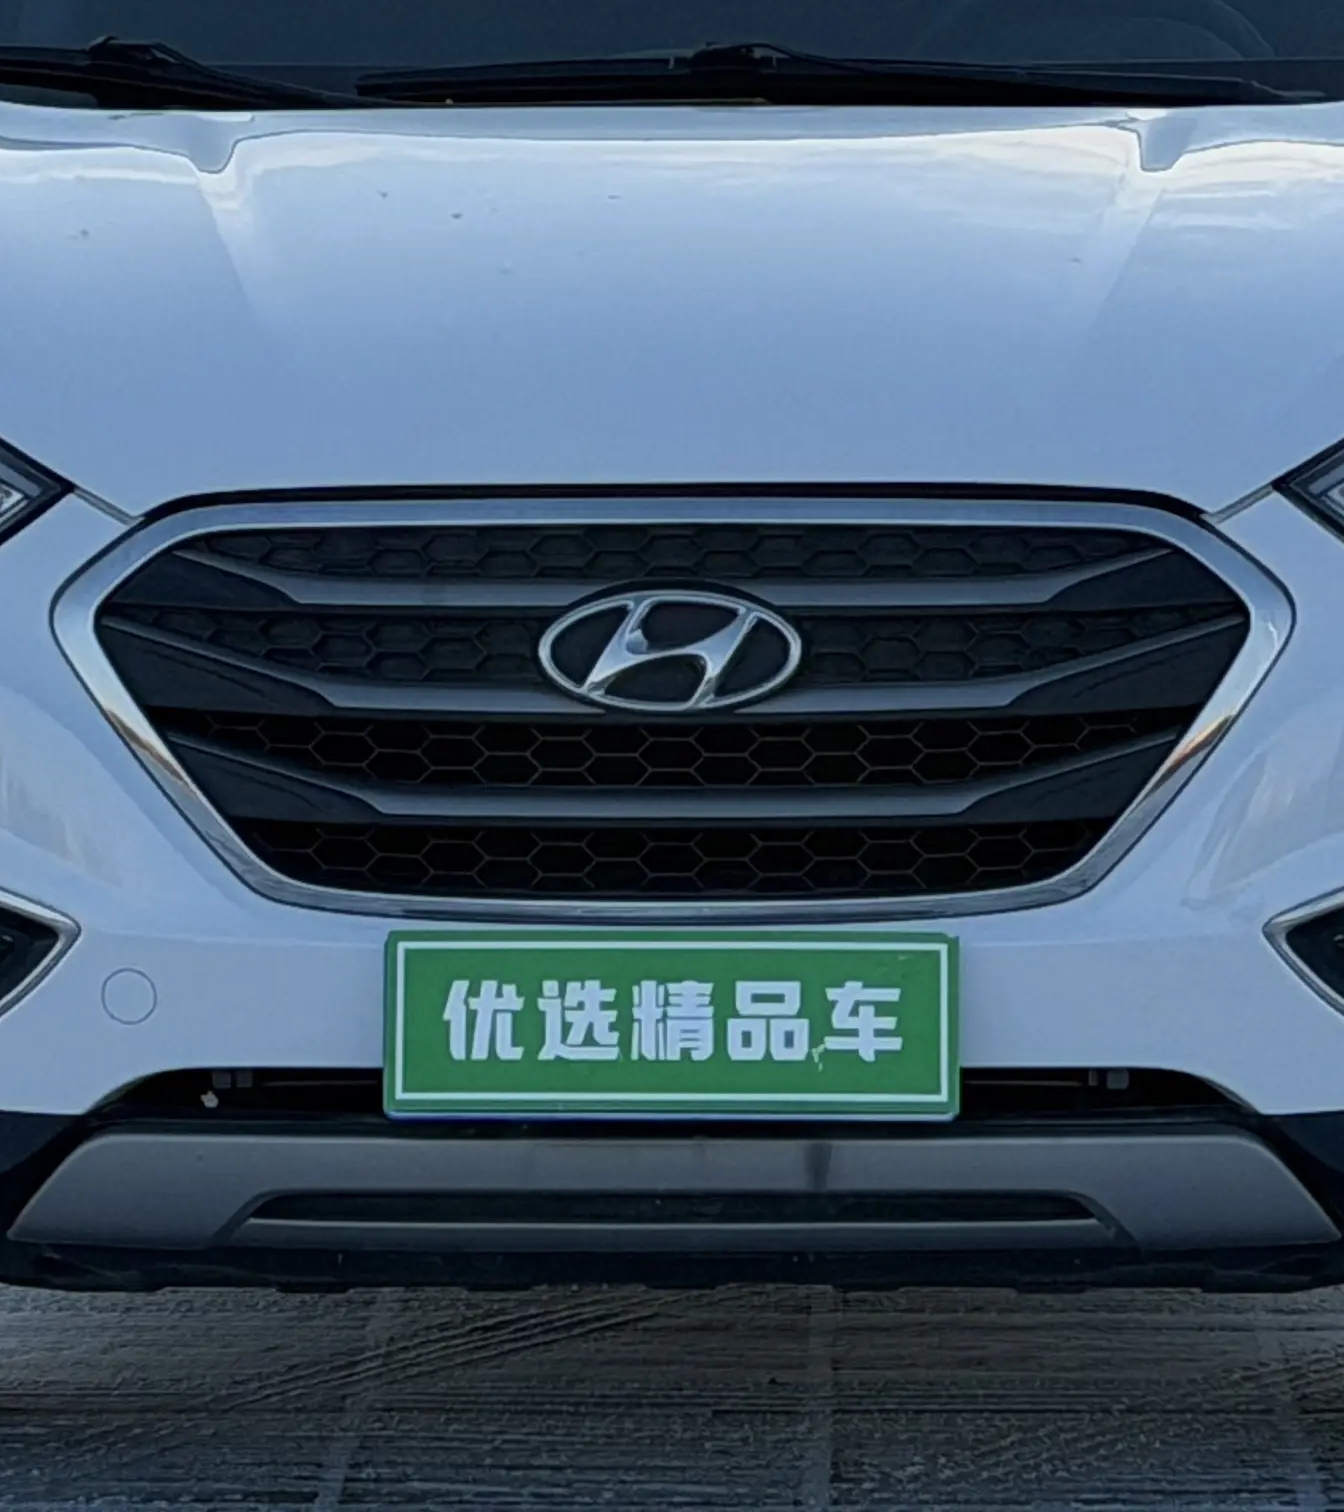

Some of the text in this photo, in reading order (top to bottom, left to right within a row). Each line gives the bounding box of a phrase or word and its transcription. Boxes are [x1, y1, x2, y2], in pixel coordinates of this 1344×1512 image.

[443, 980, 903, 1061] 优选精品车
